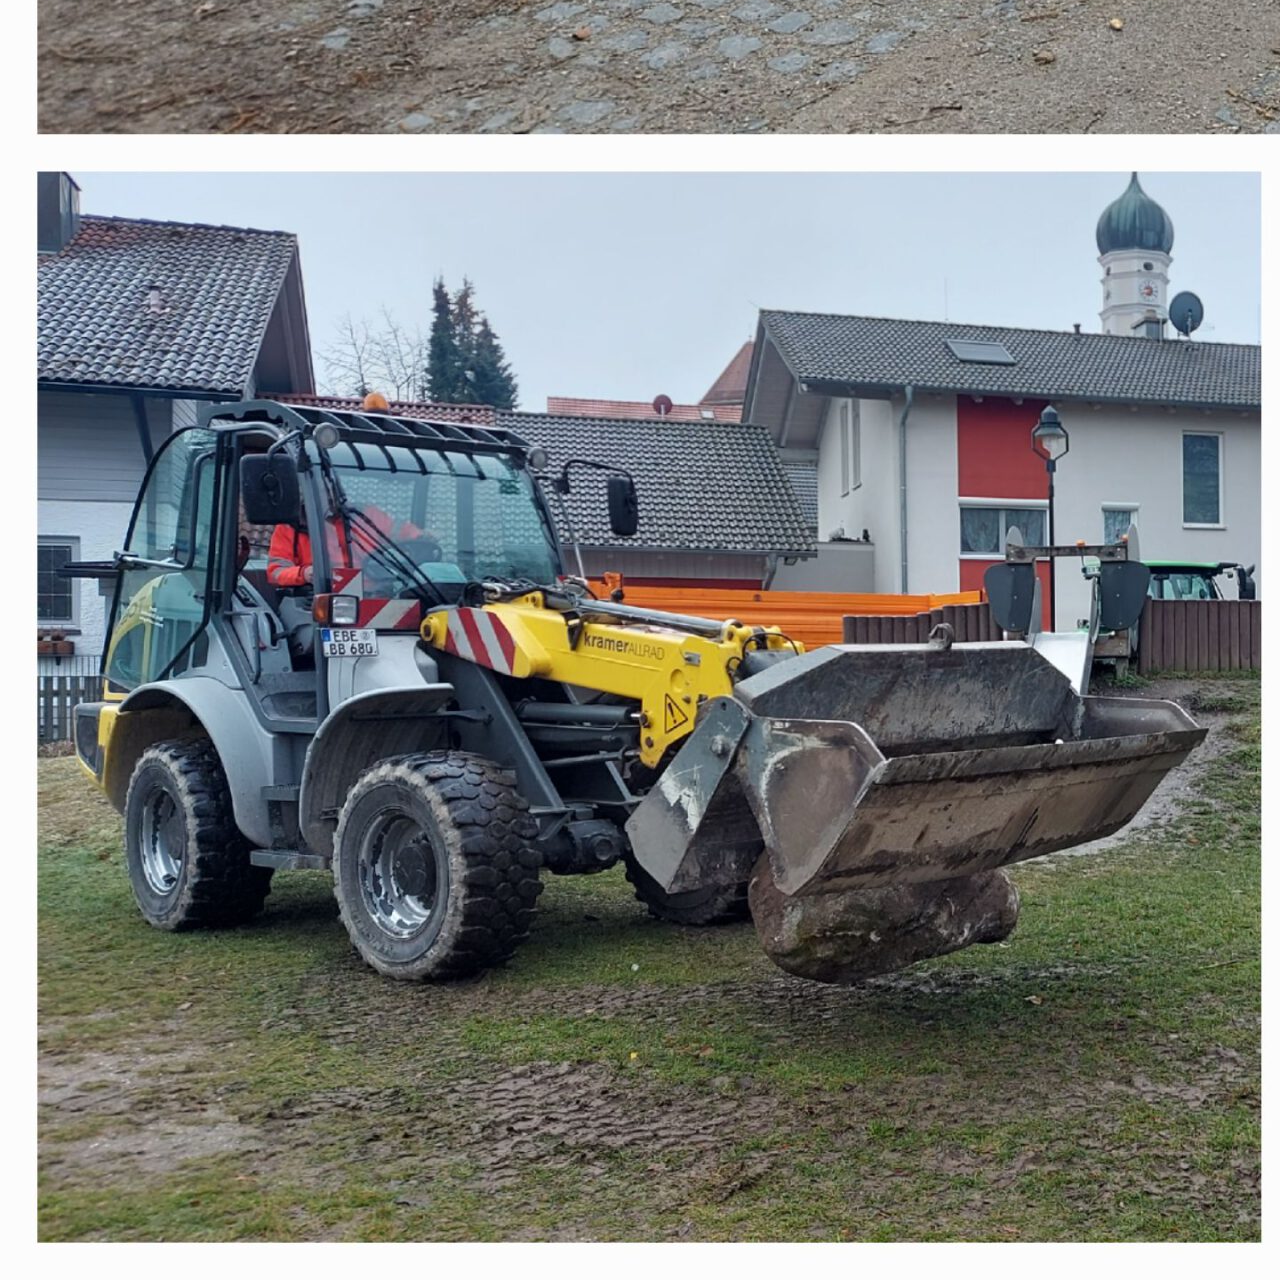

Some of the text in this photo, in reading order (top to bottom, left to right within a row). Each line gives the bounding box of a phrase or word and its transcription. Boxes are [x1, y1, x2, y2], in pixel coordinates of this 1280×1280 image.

[333, 630, 359, 642] EBE
[329, 642, 373, 655] BB 680
